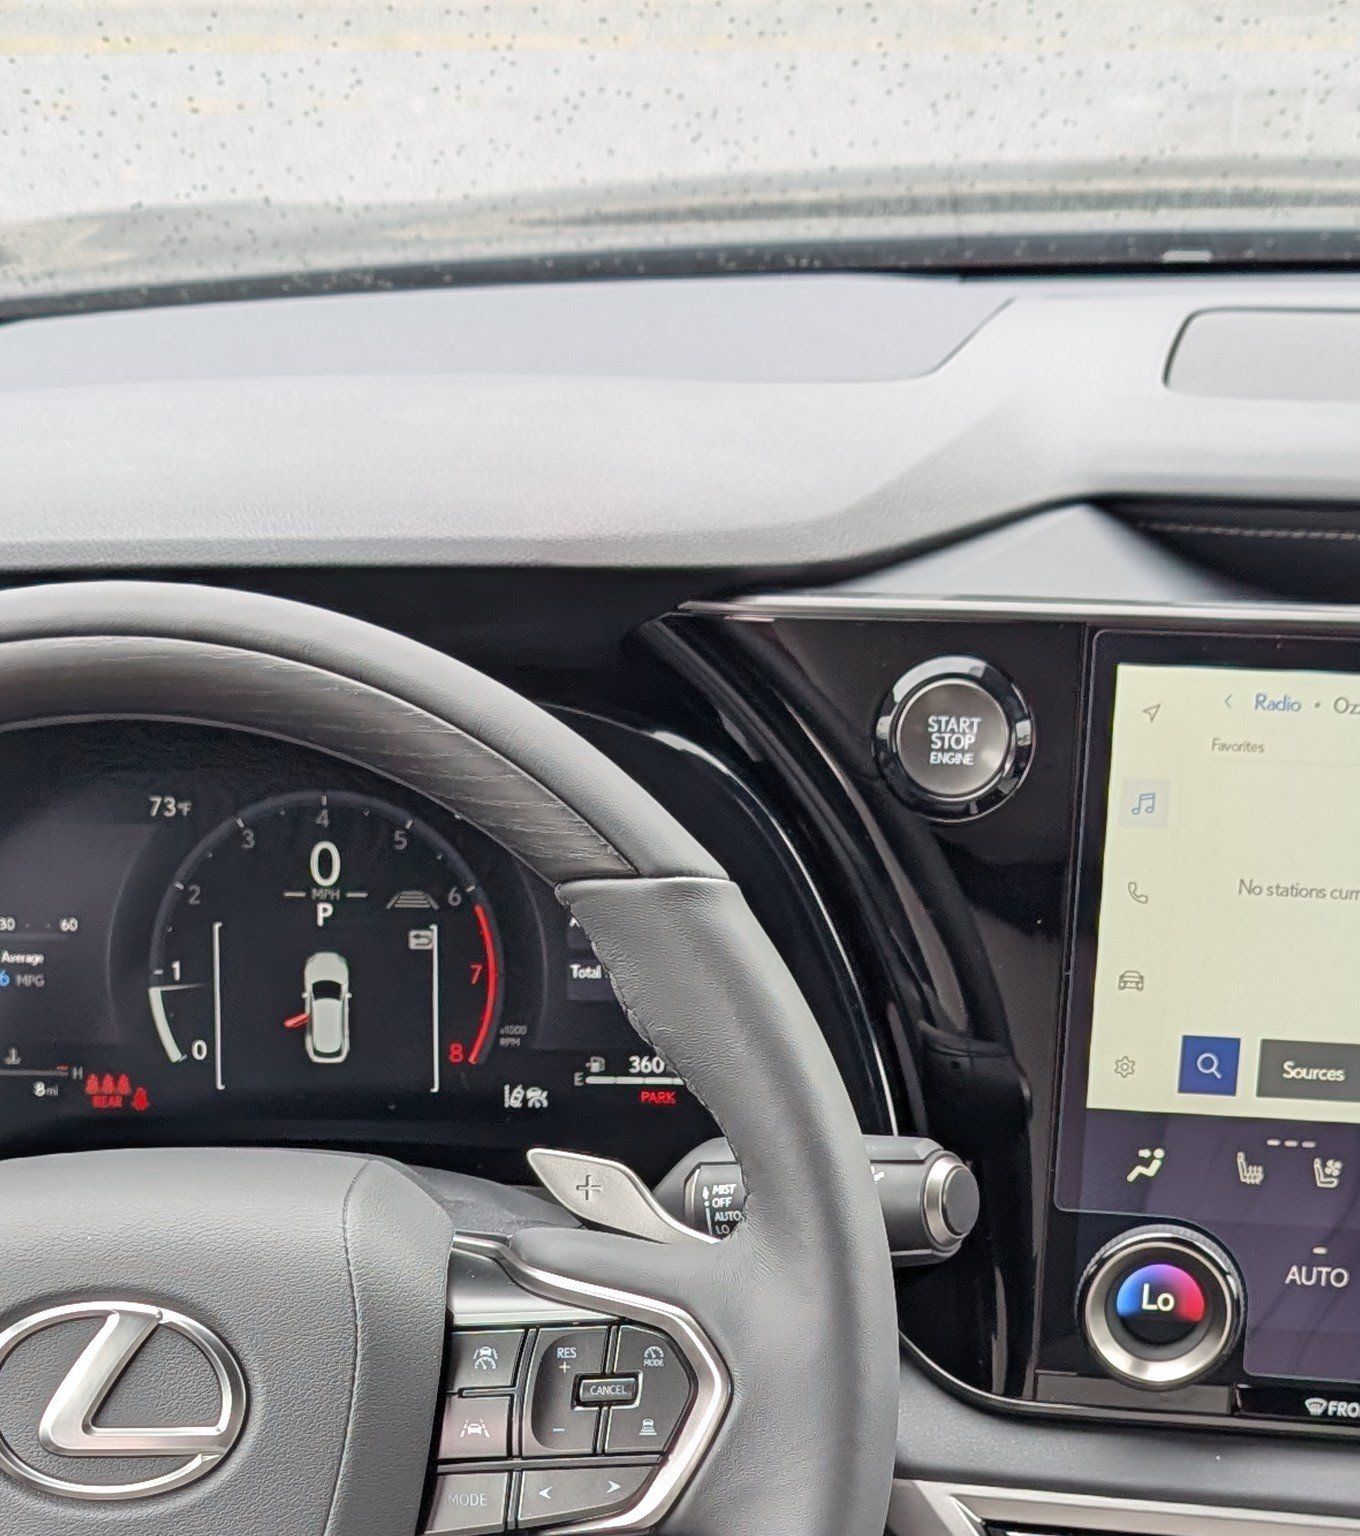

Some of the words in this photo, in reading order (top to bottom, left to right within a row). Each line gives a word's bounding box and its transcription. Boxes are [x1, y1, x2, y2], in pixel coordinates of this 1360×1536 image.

[1254, 694, 1302, 712] Radio
[927, 716, 981, 734] START
[930, 734, 975, 750] STOP
[1211, 738, 1265, 754] Favorites
[930, 752, 974, 766] ENGINE
[316, 809, 329, 827] 4
[241, 830, 256, 849] 3
[393, 830, 408, 850] 5
[310, 840, 340, 887] 0
[188, 886, 201, 905] 2
[447, 885, 462, 906] 6
[1238, 879, 1263, 897] No
[1266, 882, 1327, 899] stations
[316, 902, 334, 927] P
[60, 917, 79, 931] 60
[1, 949, 44, 966] Average
[171, 961, 181, 980] 1
[470, 965, 483, 985] 7
[569, 963, 602, 979] Total
[191, 1040, 207, 1060] 0
[449, 1043, 463, 1064] 8
[628, 1055, 665, 1074] 360
[1282, 1061, 1346, 1083] Sources
[574, 1072, 584, 1086] E
[640, 1091, 677, 1105] PARK
[712, 1183, 737, 1196] MIST
[712, 1197, 732, 1209] OFF
[714, 1211, 742, 1222] AUTO
[715, 1225, 730, 1236] LO
[1285, 1265, 1350, 1288] AUTO
[1141, 1284, 1175, 1312] Lo
[556, 1347, 577, 1359] RES
[643, 1358, 664, 1367] MODE
[589, 1383, 628, 1396] CANCEL
[448, 1493, 487, 1507] MODE
